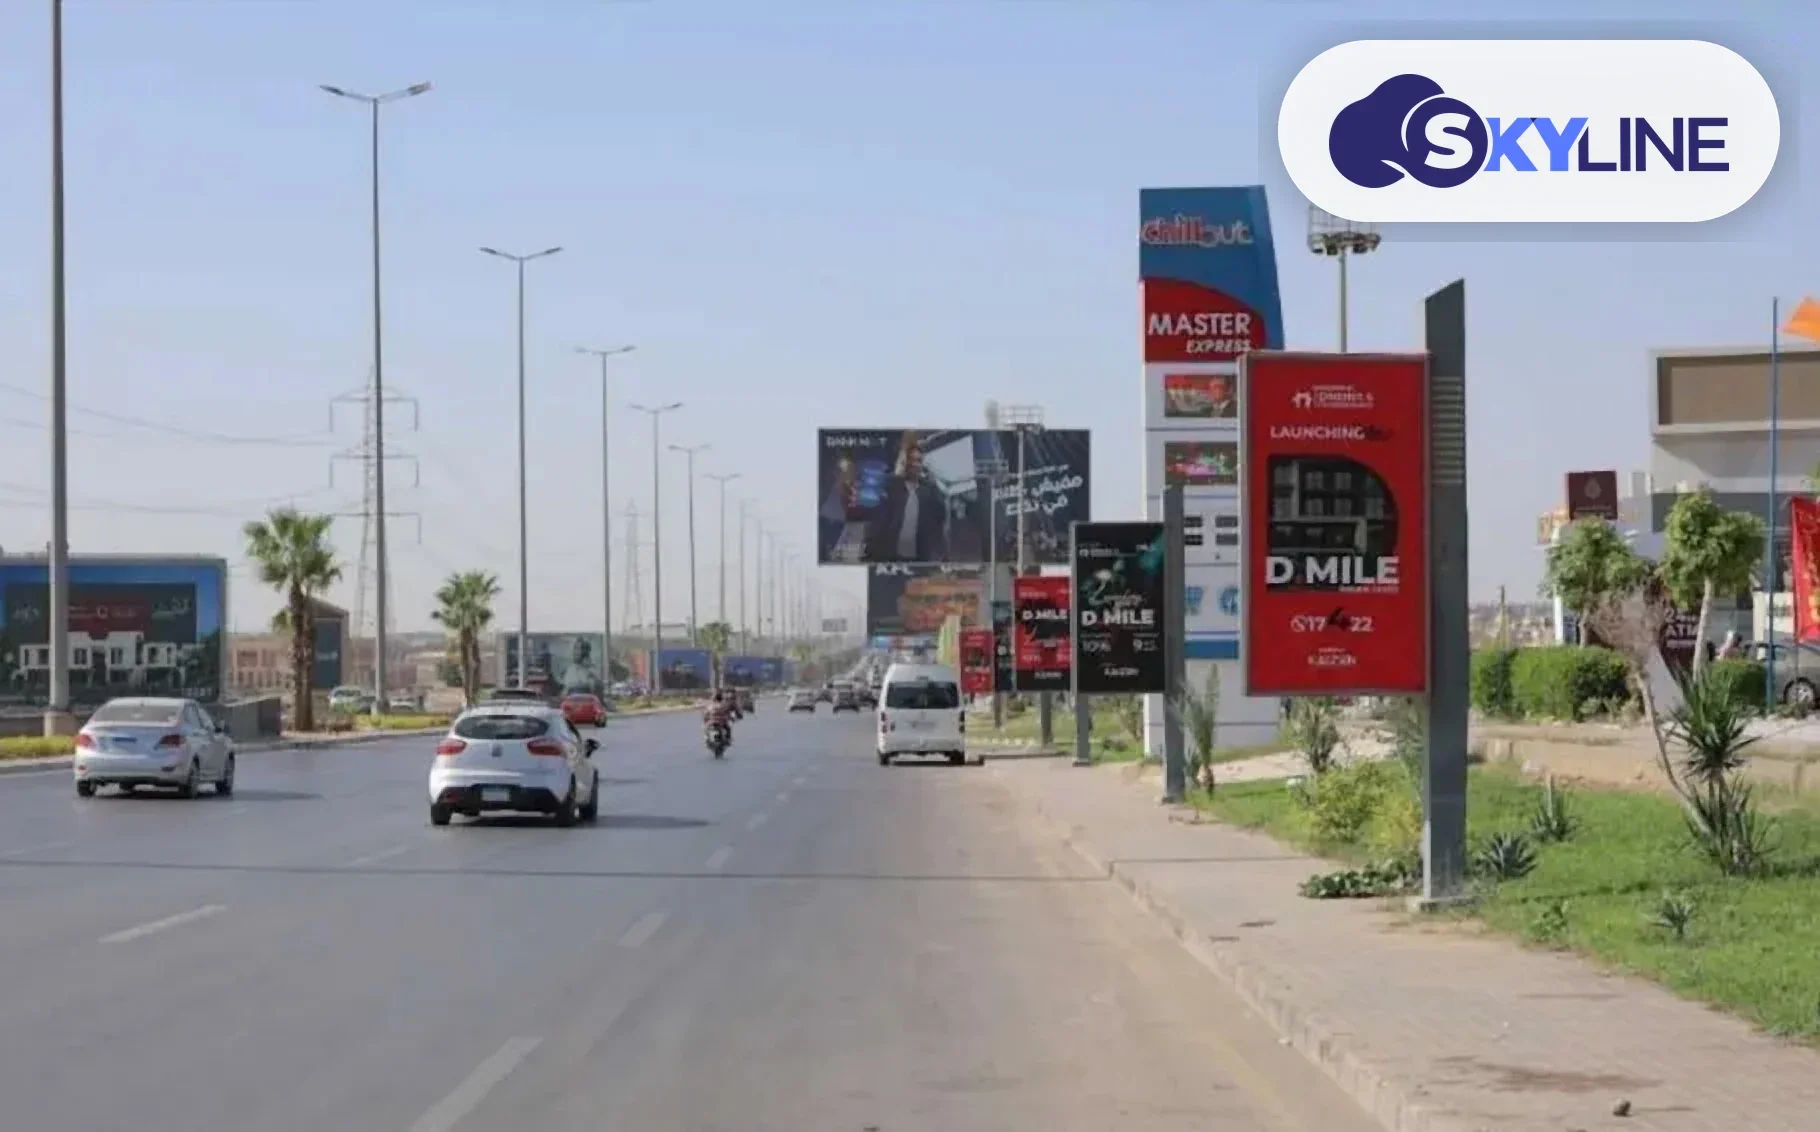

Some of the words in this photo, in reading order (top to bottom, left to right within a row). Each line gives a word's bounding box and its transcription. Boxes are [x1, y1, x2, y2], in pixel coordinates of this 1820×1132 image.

[1148, 312, 1251, 336] MASTER
[1186, 339, 1251, 354] EXPRESS
[1270, 426, 1366, 440] LAUNCHING
[1306, 556, 1400, 585] MILE
[1103, 608, 1154, 625] MILE
